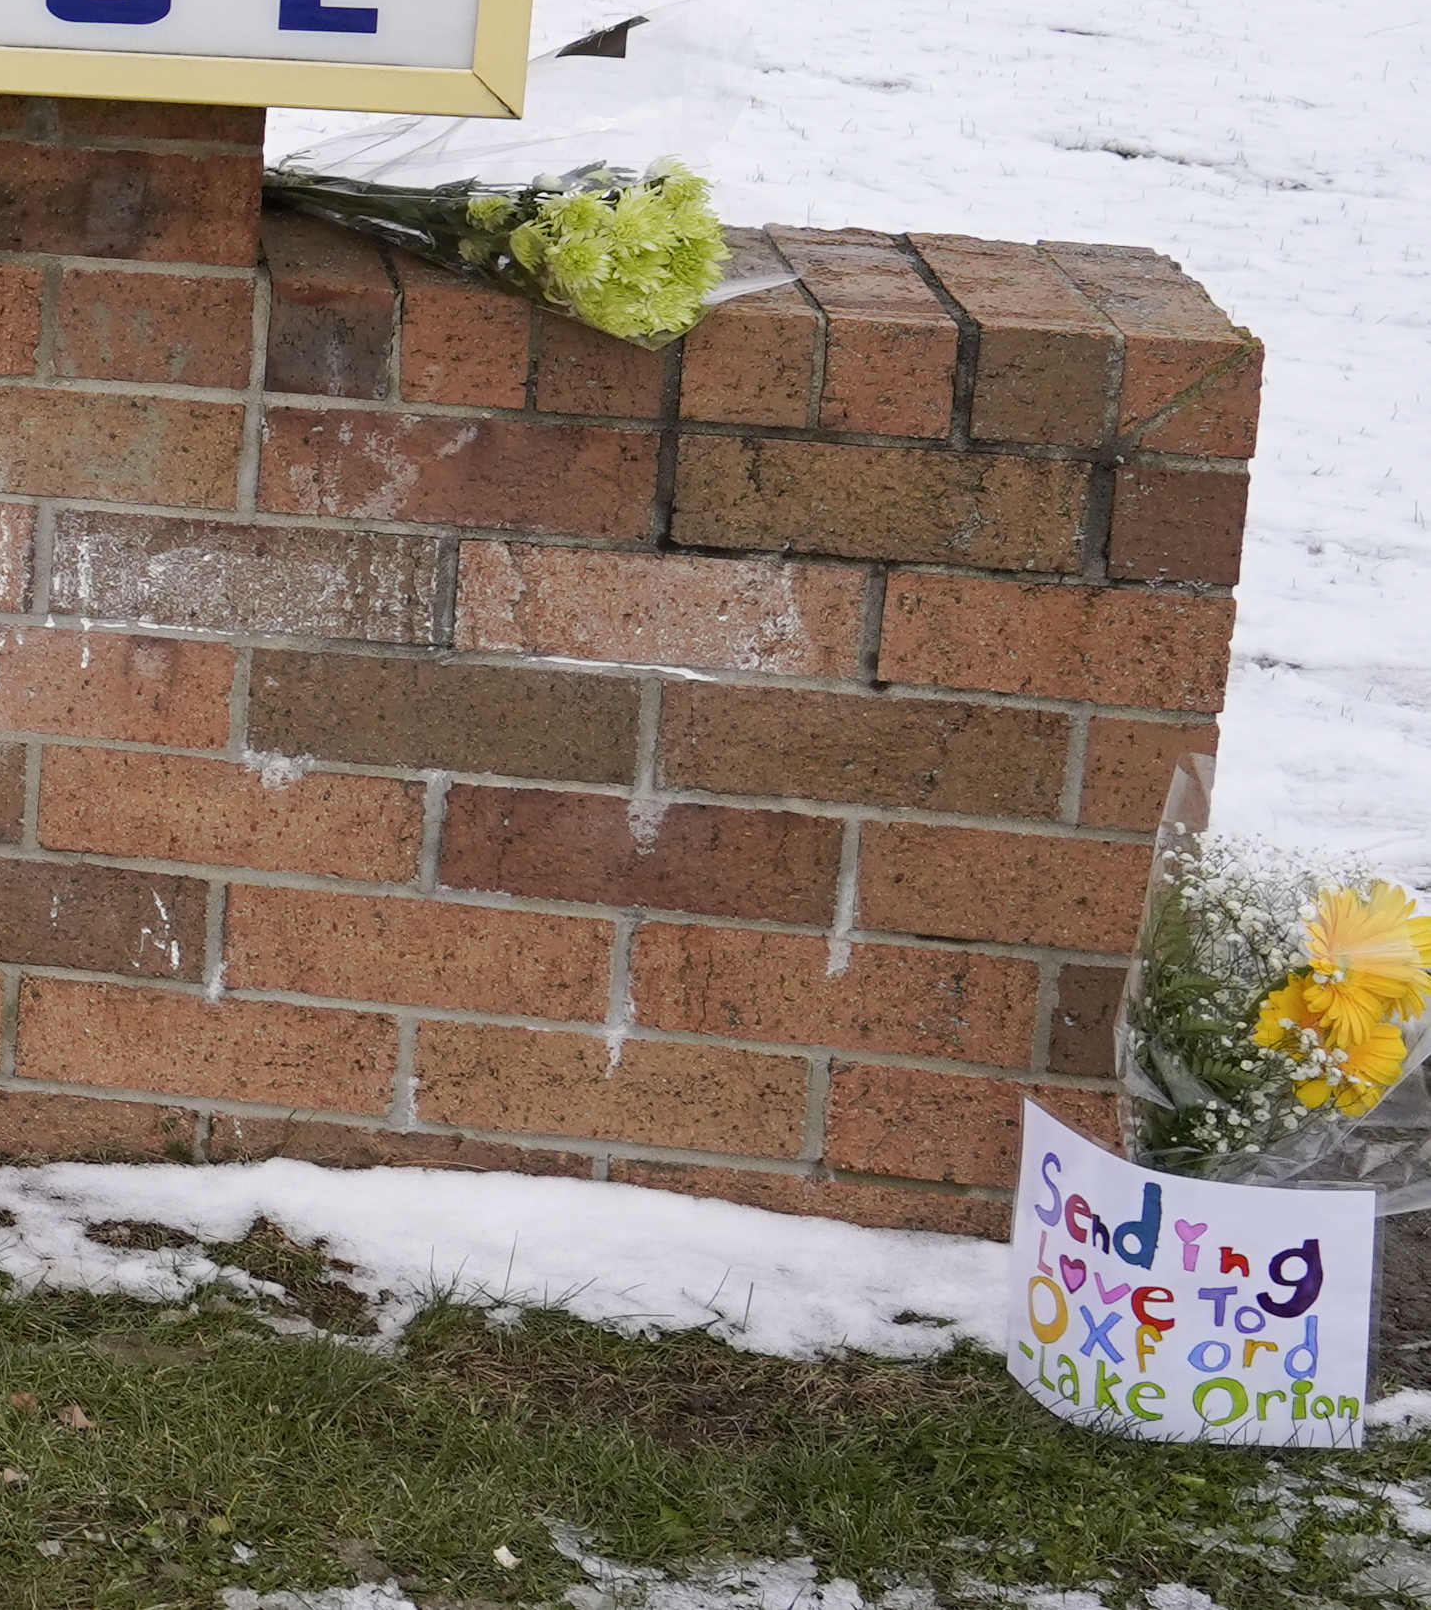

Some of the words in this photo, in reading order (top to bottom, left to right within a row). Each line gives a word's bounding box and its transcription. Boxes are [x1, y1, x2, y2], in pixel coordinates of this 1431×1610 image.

[1033, 1151, 1325, 1319] Sending
[1027, 1274, 1319, 1380] Oxford
[1192, 1376, 1361, 1428] Orion
